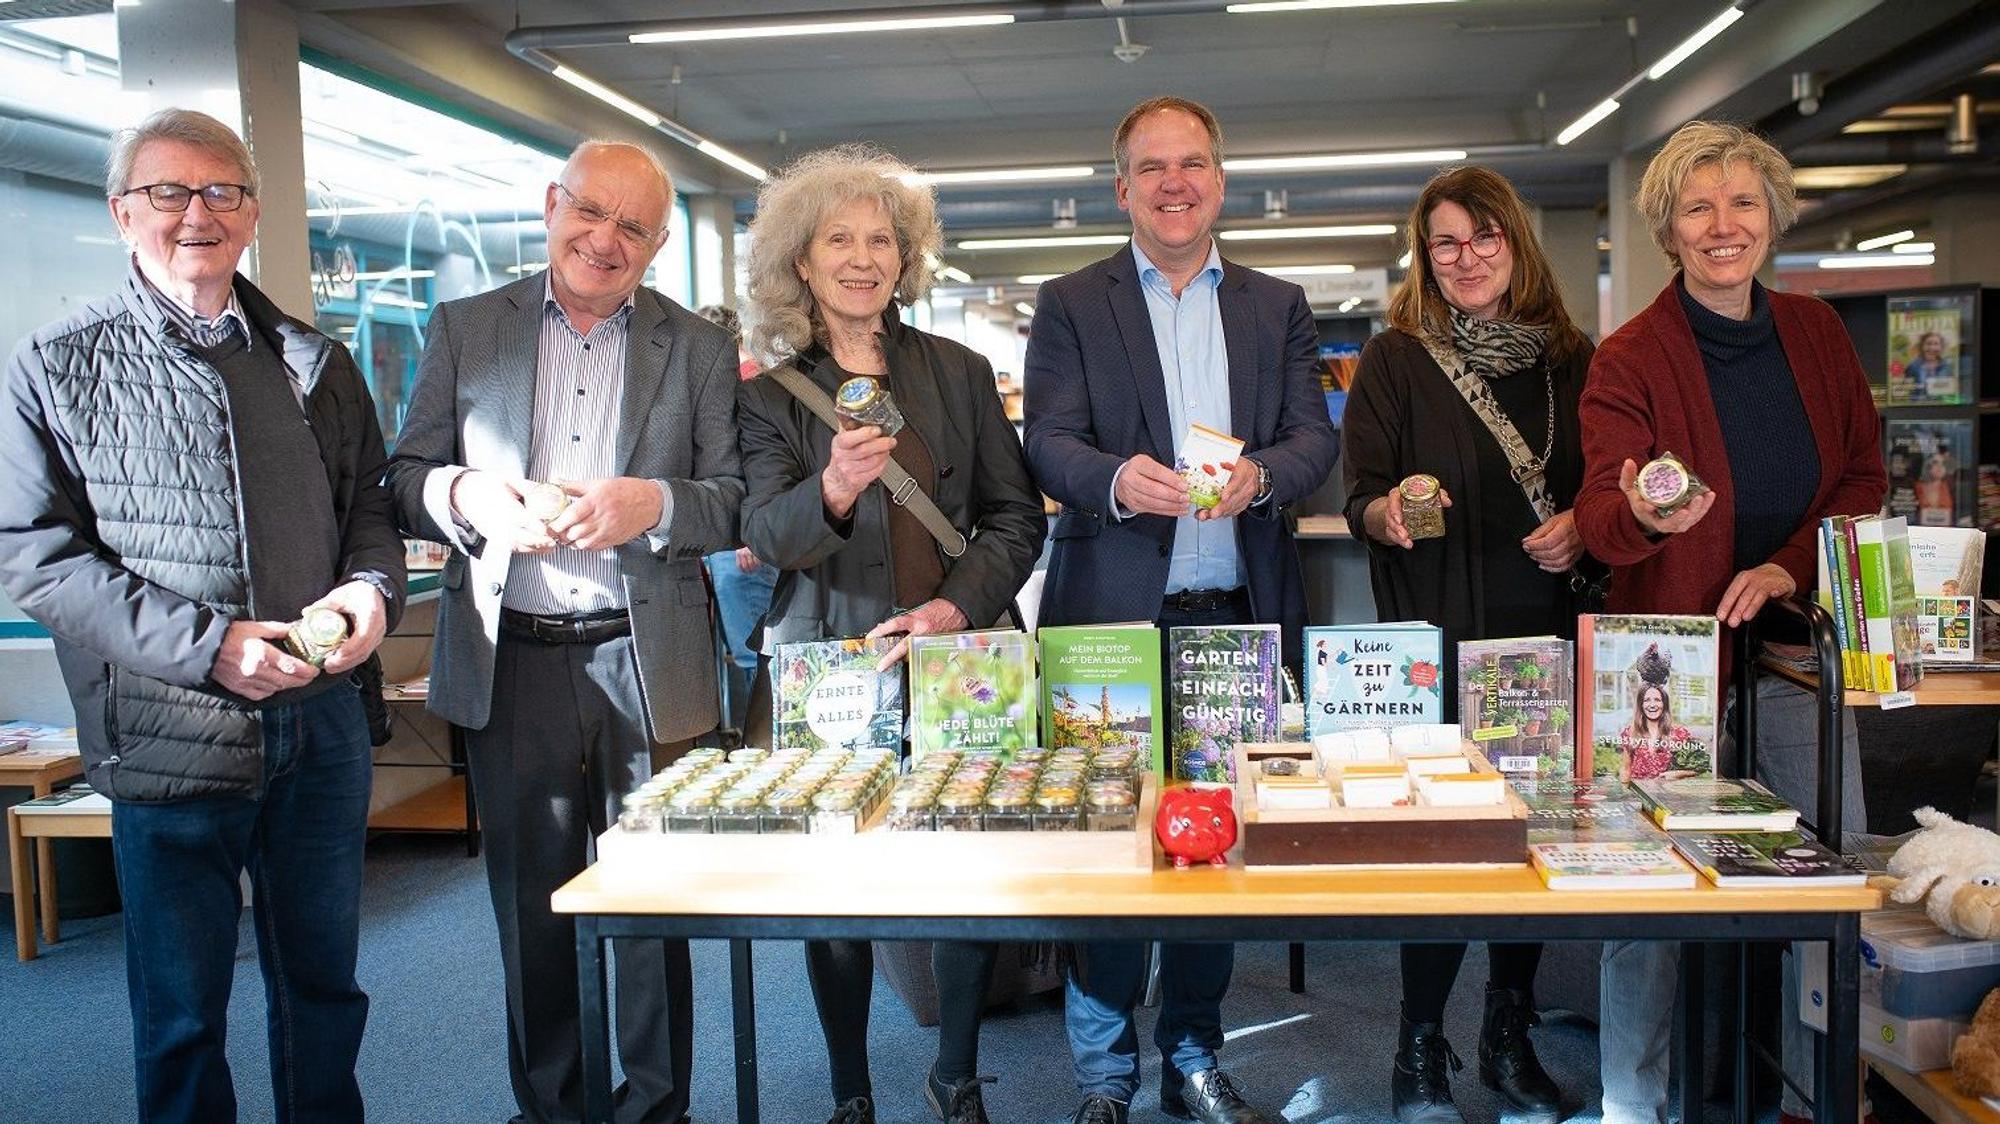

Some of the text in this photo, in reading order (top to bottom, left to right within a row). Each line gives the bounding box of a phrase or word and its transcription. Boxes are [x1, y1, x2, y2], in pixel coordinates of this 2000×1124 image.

[1068, 644, 1131, 654] MEIN BIOTOP
[1354, 638, 1393, 654] Keine
[1059, 655, 1143, 665] AUF DEM BALKON
[1181, 649, 1258, 666] GARTEN
[1354, 664, 1392, 677] ZEIT
[816, 685, 864, 699] ERNTE
[1182, 680, 1267, 697] EINFACH
[1363, 682, 1385, 697] zu
[1468, 682, 1485, 691] Der
[1486, 659, 1498, 716] VERTIKALE
[1498, 689, 1539, 698] Balkon &
[1323, 699, 1424, 715] GÄRTNERN
[1498, 699, 1568, 709] Terrassengarten
[816, 709, 864, 723] ALLES
[1182, 702, 1266, 723] GÜNSTIG
[936, 714, 1014, 731] JEDE BLÜTE
[953, 730, 1000, 745] ZÄHLT!
[1598, 734, 1706, 751] SELBSTVERSORGUNG
